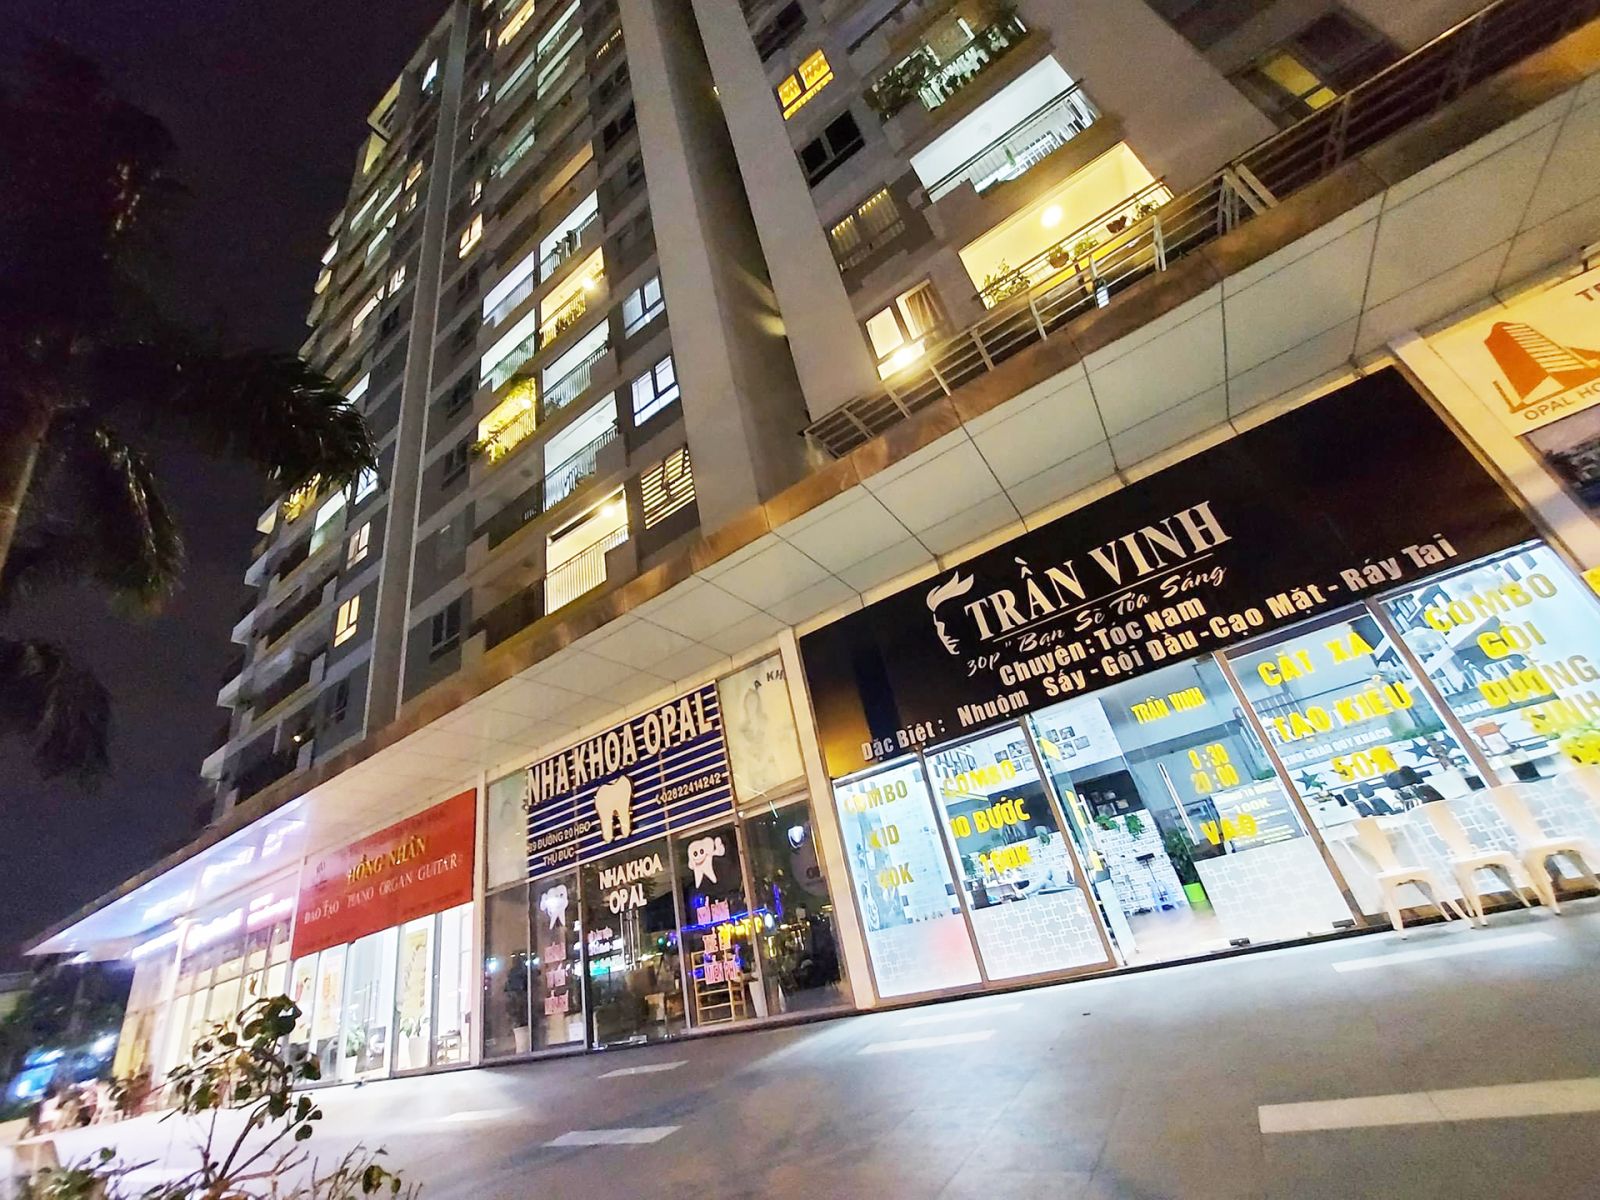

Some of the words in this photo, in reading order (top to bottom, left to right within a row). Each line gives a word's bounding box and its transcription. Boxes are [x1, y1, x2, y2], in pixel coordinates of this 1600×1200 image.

[1524, 398, 1576, 421] OPAL
[964, 556, 1087, 641] TRẦN
[1087, 500, 1232, 585] VINH
[1159, 566, 1228, 598] Sáng
[1424, 573, 1558, 632] COMBO
[957, 690, 1029, 727] Nhuộm
[1043, 669, 1087, 697] Sấy
[1101, 645, 1144, 675] Gội
[1209, 608, 1265, 636] Cạo
[1265, 587, 1327, 615] Mặt
[1340, 558, 1403, 593] Ráy
[1401, 533, 1458, 568] Tai
[1093, 622, 1143, 651] Tóc
[1144, 597, 1207, 633] Nam
[1167, 686, 1207, 713] VINH
[527, 753, 570, 806] NHA
[572, 723, 639, 787] KHOA
[643, 691, 713, 756] OPAL
[843, 779, 908, 814] COMBO
[942, 759, 1017, 798] COMBO
[972, 796, 1031, 834] BƯỚC
[868, 823, 900, 849] KID
[379, 871, 413, 895] ORGAN
[417, 852, 459, 881] GUITAR
[609, 883, 648, 915] OPAL
